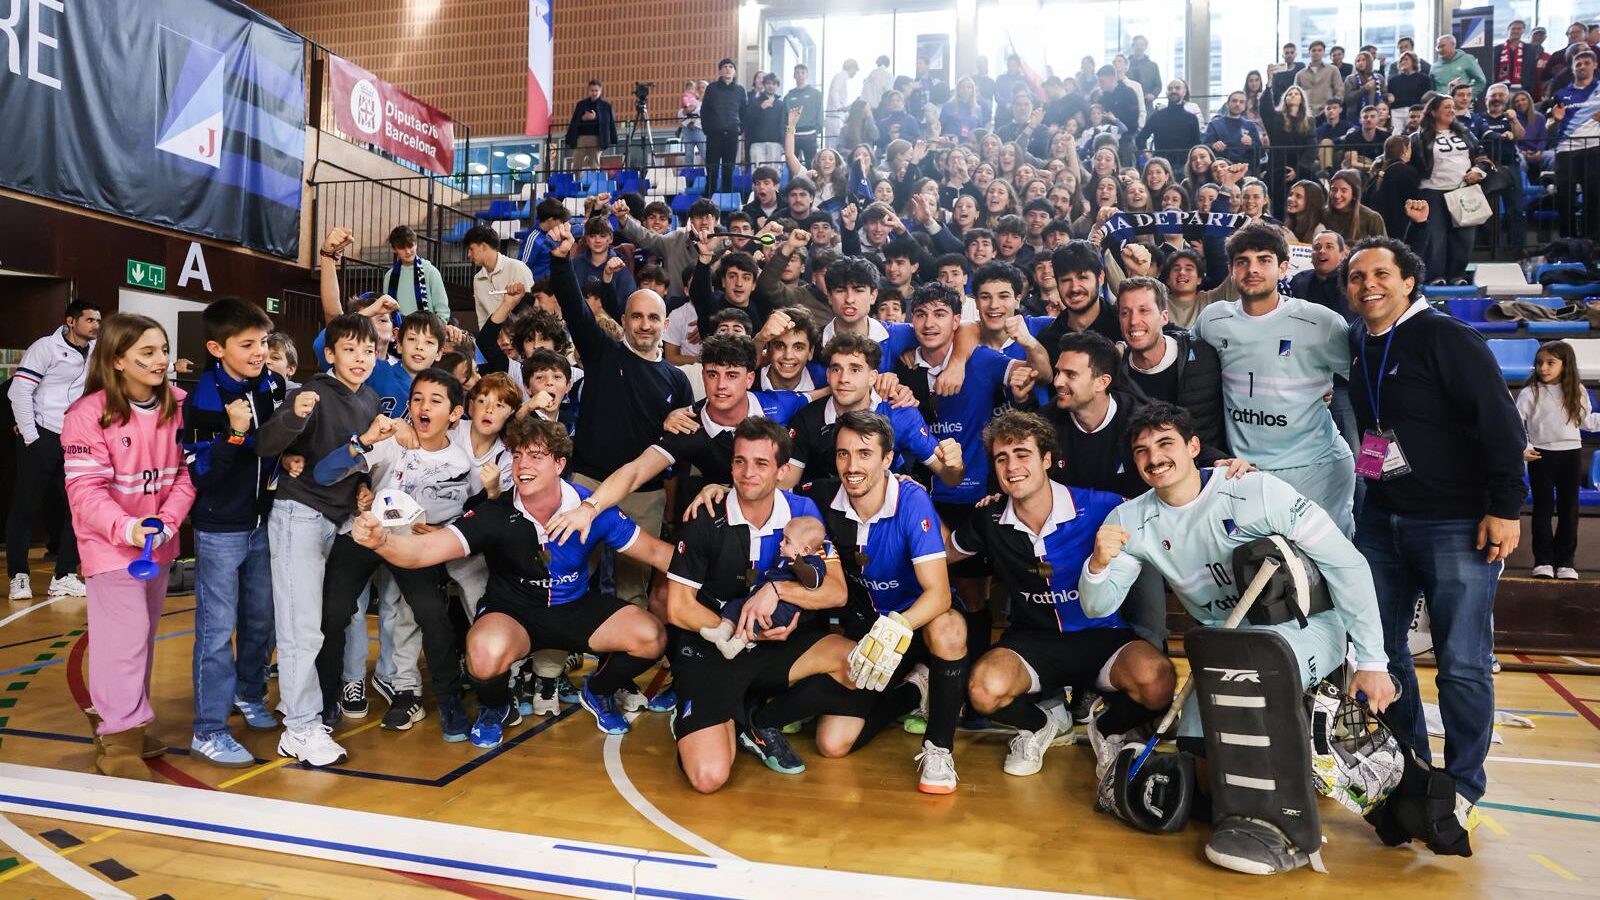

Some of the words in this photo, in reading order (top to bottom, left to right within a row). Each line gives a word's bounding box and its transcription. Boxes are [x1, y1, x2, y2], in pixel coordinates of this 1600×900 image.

[198, 127, 217, 158] J
[385, 120, 437, 158] Barcelona
[1133, 211, 1170, 227] DE
[177, 241, 213, 292] A
[1248, 371, 1254, 398] 1
[1232, 408, 1288, 427] athlos
[1205, 562, 1232, 588] 10
